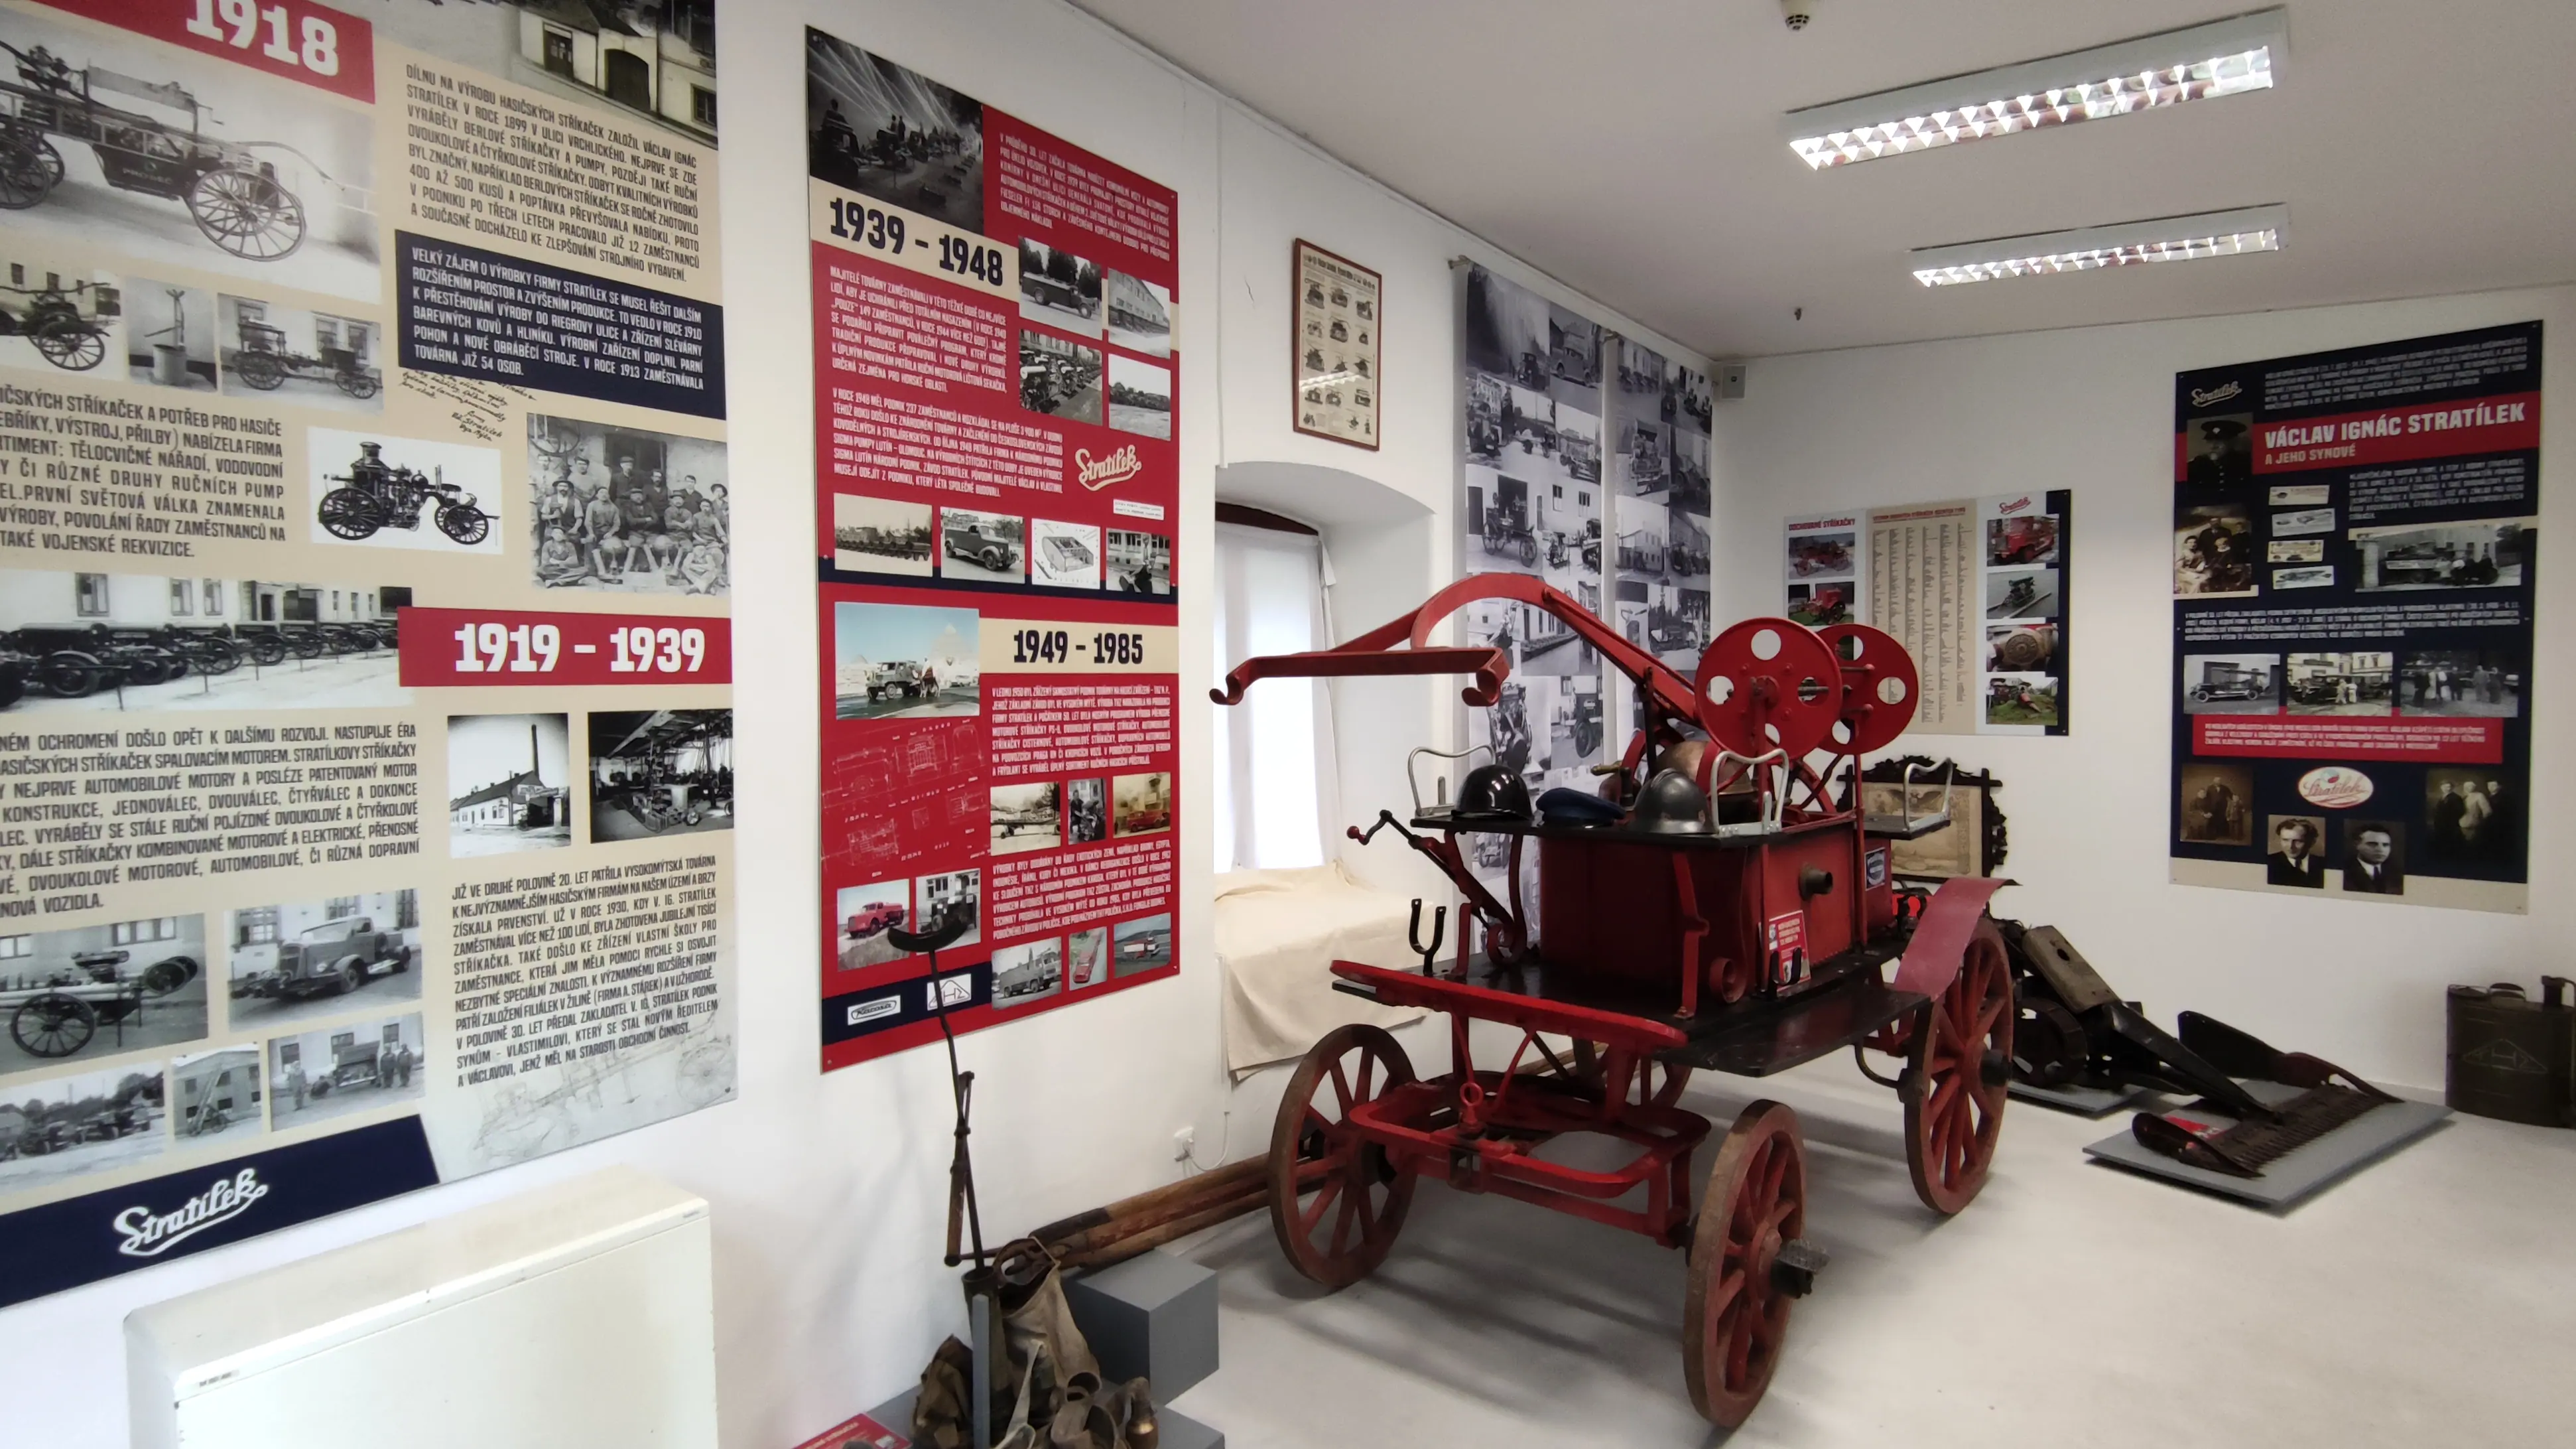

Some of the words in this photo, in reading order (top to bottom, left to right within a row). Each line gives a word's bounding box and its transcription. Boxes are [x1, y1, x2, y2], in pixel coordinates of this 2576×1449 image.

[186, 0, 339, 76] 1918
[406, 64, 436, 86] DÍLNU
[440, 75, 454, 92] NA
[457, 81, 496, 105] VÝROBU
[499, 94, 555, 124] HASIČSKÝCH
[558, 113, 604, 139] STŘÍKAČEK
[608, 129, 639, 151] ZALOŽIL
[642, 140, 671, 161] VÁCLAV
[674, 151, 697, 169] IGNÁC
[406, 83, 459, 112] STRATÍLEK
[463, 102, 470, 115] V
[474, 105, 499, 125] ROCE
[504, 115, 527, 133] 1899
[531, 123, 538, 137] V
[541, 126, 564, 145] ULICI
[630, 154, 666, 176] NEJPRVE
[669, 166, 679, 180] SE
[682, 170, 698, 186] ZDE
[407, 104, 458, 131] VYRÁBĚLY
[464, 121, 505, 145] BERLOVÉ
[509, 135, 560, 161] STŘÍKAČKY
[565, 151, 571, 165] A
[611, 165, 647, 187] POZDĚJI
[650, 176, 670, 194] TAKÉ
[674, 184, 698, 202] RUČNÍ
[830, 197, 905, 254] 1939
[939, 234, 1003, 286] 1948
[411, 246, 443, 266] VELKÝ
[445, 253, 480, 274] ZÁJEM
[480, 261, 488, 276] O
[489, 263, 533, 286] VÝROBKY
[533, 273, 562, 292] FIRMY
[562, 280, 608, 303] STRATÍLEK
[608, 291, 620, 306] SE
[620, 293, 648, 312] MUSEL
[649, 297, 672, 317] ŘEŠIT
[673, 306, 702, 324] DALŠÍM
[413, 305, 472, 329] BAREVNÝCH
[476, 317, 502, 335] KOVŮ
[505, 323, 513, 337] A
[559, 333, 598, 354] VÝROBNÍ
[602, 342, 641, 362] ZAŘÍZENÍ
[643, 350, 677, 369] DOPLNIL
[680, 358, 704, 374] PARNÍ
[415, 344, 459, 365] TOVÁRNA
[461, 353, 478, 368] JIŽ
[480, 355, 494, 371] 54
[66, 393, 145, 421] STŘÍKAČEK
[147, 406, 156, 422] A
[159, 407, 210, 429] POTŘEB
[212, 414, 237, 432] PRO
[239, 417, 282, 437] HASIČE
[2265, 425, 2335, 449] VÁCLAV
[2341, 417, 2402, 441] IGNÁC
[2408, 402, 2526, 435] STRATÍLEK
[2265, 454, 2273, 465] A
[2276, 451, 2306, 464] JEHO
[2309, 444, 2356, 460] SYNOVÉ
[80, 488, 146, 510] SVĚTOVÁ
[153, 494, 198, 514] VÁLKA
[206, 500, 285, 521] ZNAMENALA
[42, 533, 116, 553] VOJENSKÉ
[454, 622, 560, 672] 1919
[610, 627, 705, 673] 1939
[1013, 630, 1068, 663] 1949
[1094, 633, 1143, 664] 1985
[37, 730, 119, 752] OCHROMENÍ
[125, 729, 166, 748] DOŠLO
[172, 728, 204, 746] OPĚT
[210, 730, 219, 745] K
[224, 726, 275, 744] DALŠÍMU
[334, 724, 393, 740] NASTUPUJE
[397, 722, 417, 738] ÉRA
[288, 785, 351, 804] ČTYŘVÁLEC
[356, 786, 364, 799] A
[369, 782, 418, 799] DOKONCE
[451, 882, 468, 901] JIŽ
[470, 884, 482, 898] VE
[483, 878, 514, 896] DRUHÉ
[516, 872, 556, 892] POLOVINĚ
[574, 870, 589, 885] LET
[591, 866, 622, 882] PATŘILA
[623, 858, 684, 878] VYSOKOMÝTSKÁ
[685, 855, 716, 870] TOVÁRNA
[518, 946, 542, 965] TAKÉ
[547, 942, 576, 960] DOŠLO
[580, 939, 592, 953] KE
[596, 931, 632, 951] ZŘÍZENÍ
[635, 925, 670, 944] VLASTNÍ
[673, 922, 698, 937] ŠKOLY
[701, 918, 717, 932] PRO
[856, 1002, 893, 1018] Karosa
[456, 1050, 491, 1070] SYNŮM
[575, 1022, 602, 1042] KTERÝ
[606, 1021, 617, 1036] SE
[621, 1016, 641, 1032] STAL
[644, 1008, 673, 1026] NOVÝM
[676, 999, 719, 1019] ŘEDITELEM
